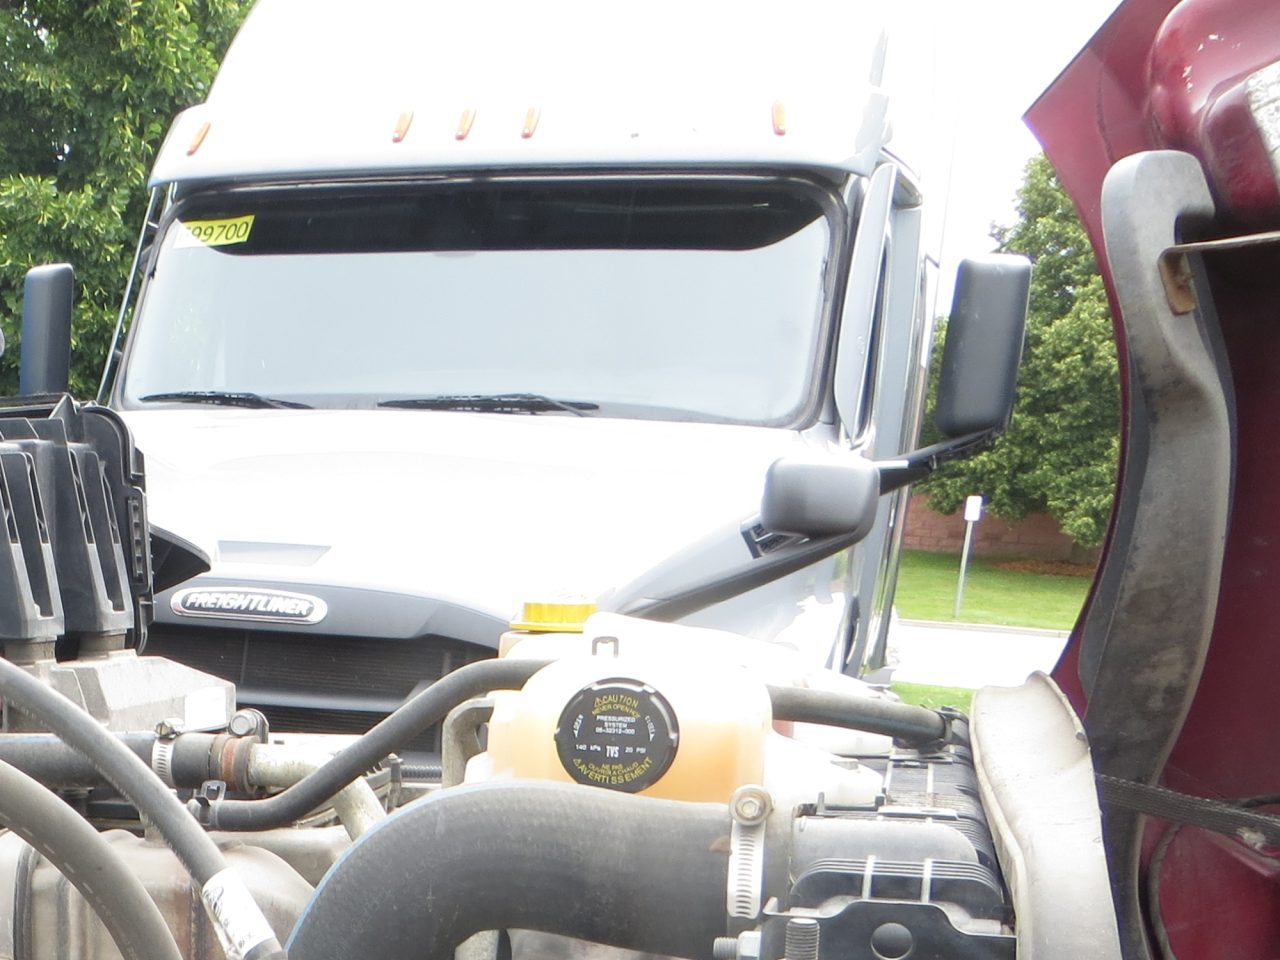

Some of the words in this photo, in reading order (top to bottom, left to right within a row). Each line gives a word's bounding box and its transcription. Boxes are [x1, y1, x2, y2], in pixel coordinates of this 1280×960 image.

[186, 221, 249, 242] 99700
[185, 592, 310, 615] FREIGHTLINER
[601, 694, 639, 708] CAUTION
[606, 745, 619, 758] TVS
[578, 757, 652, 784] AVERTISSEMENT
